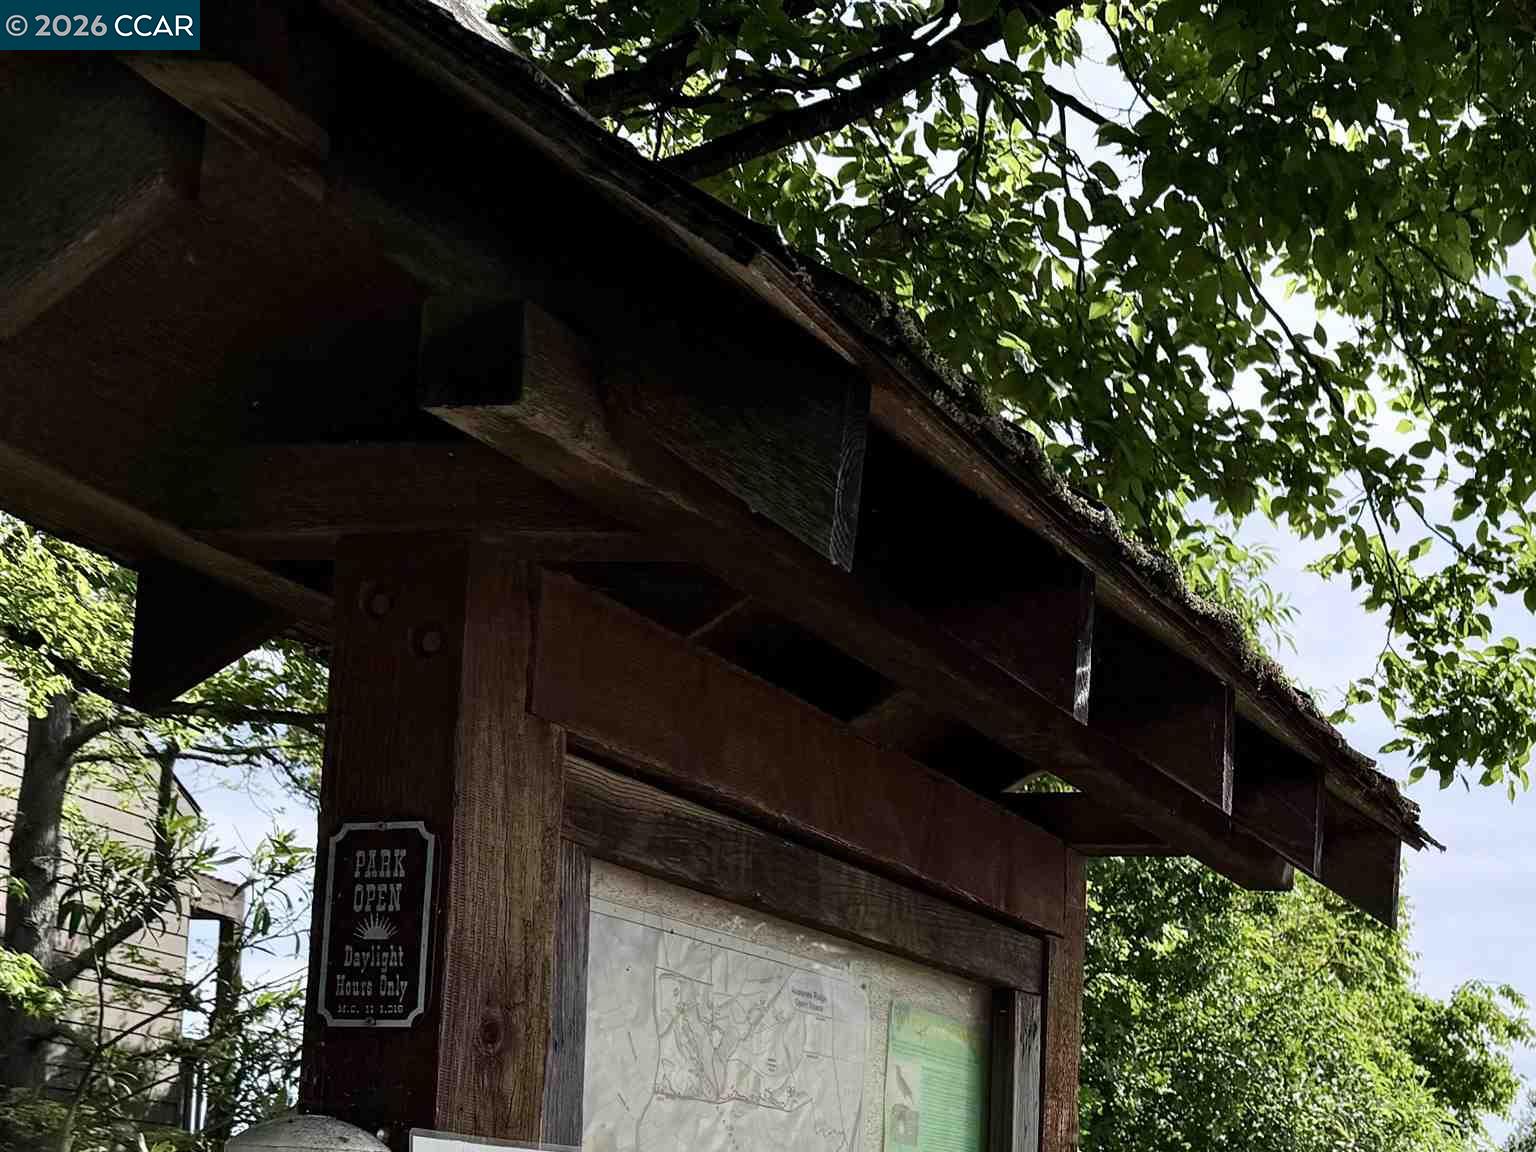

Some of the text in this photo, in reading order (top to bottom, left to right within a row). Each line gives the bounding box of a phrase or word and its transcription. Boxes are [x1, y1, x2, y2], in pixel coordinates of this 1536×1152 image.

[354, 849, 407, 878] PARK
[353, 883, 403, 912] OPEN
[344, 945, 404, 974] Daylight
[335, 974, 408, 1002] Hours Only
